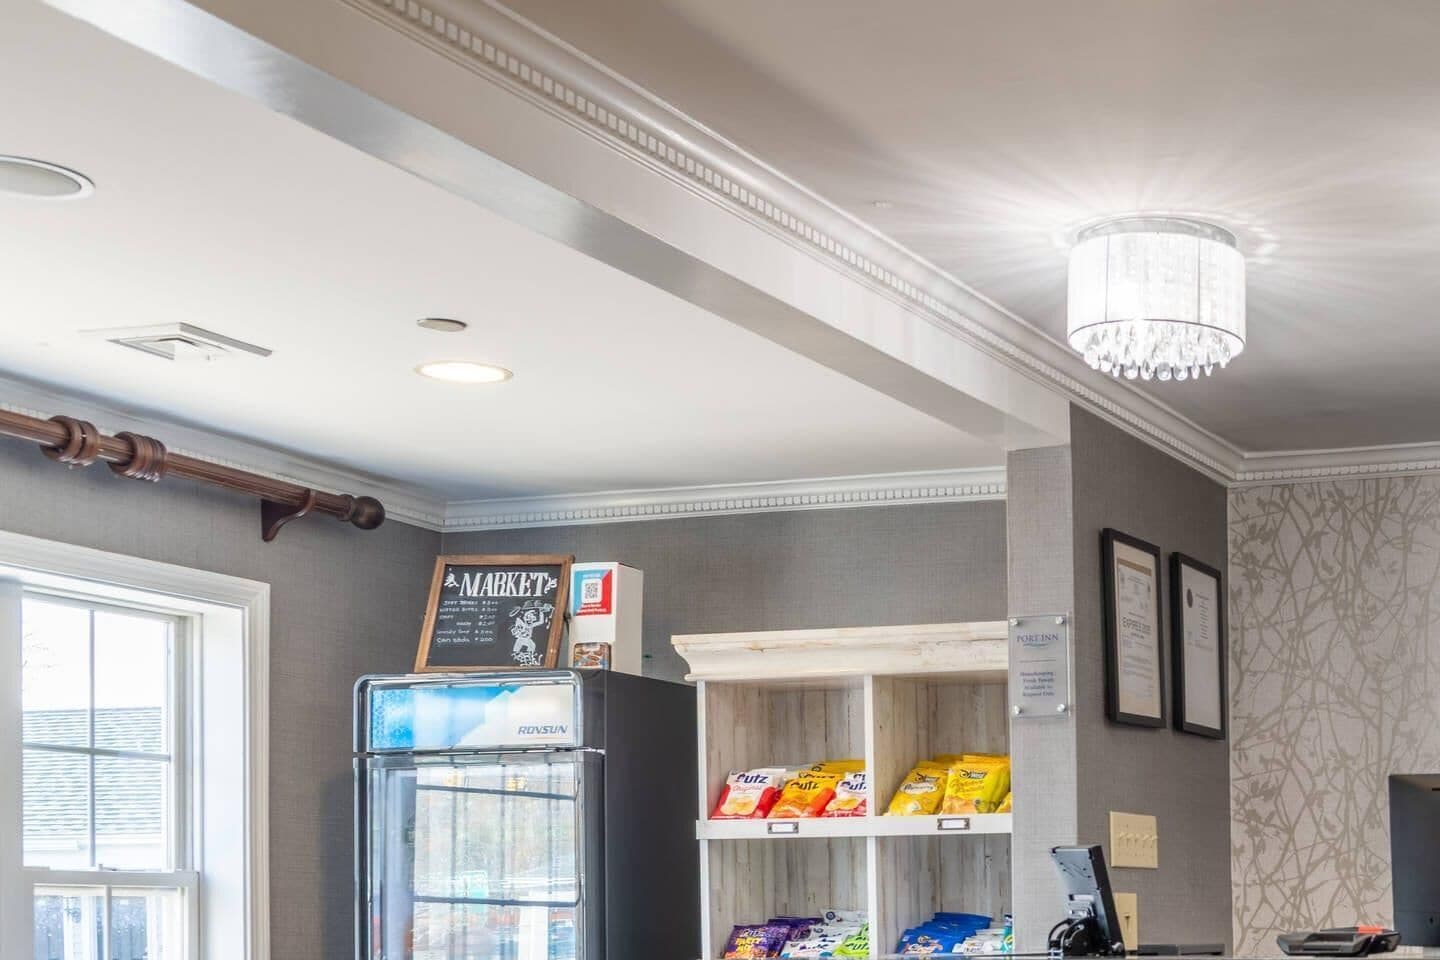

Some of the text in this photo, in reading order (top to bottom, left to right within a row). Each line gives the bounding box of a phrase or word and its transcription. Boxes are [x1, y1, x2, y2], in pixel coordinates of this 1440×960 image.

[459, 572, 549, 597] MARKET
[1016, 632, 1059, 642] PORT INN
[518, 725, 568, 735] ROVSUN
